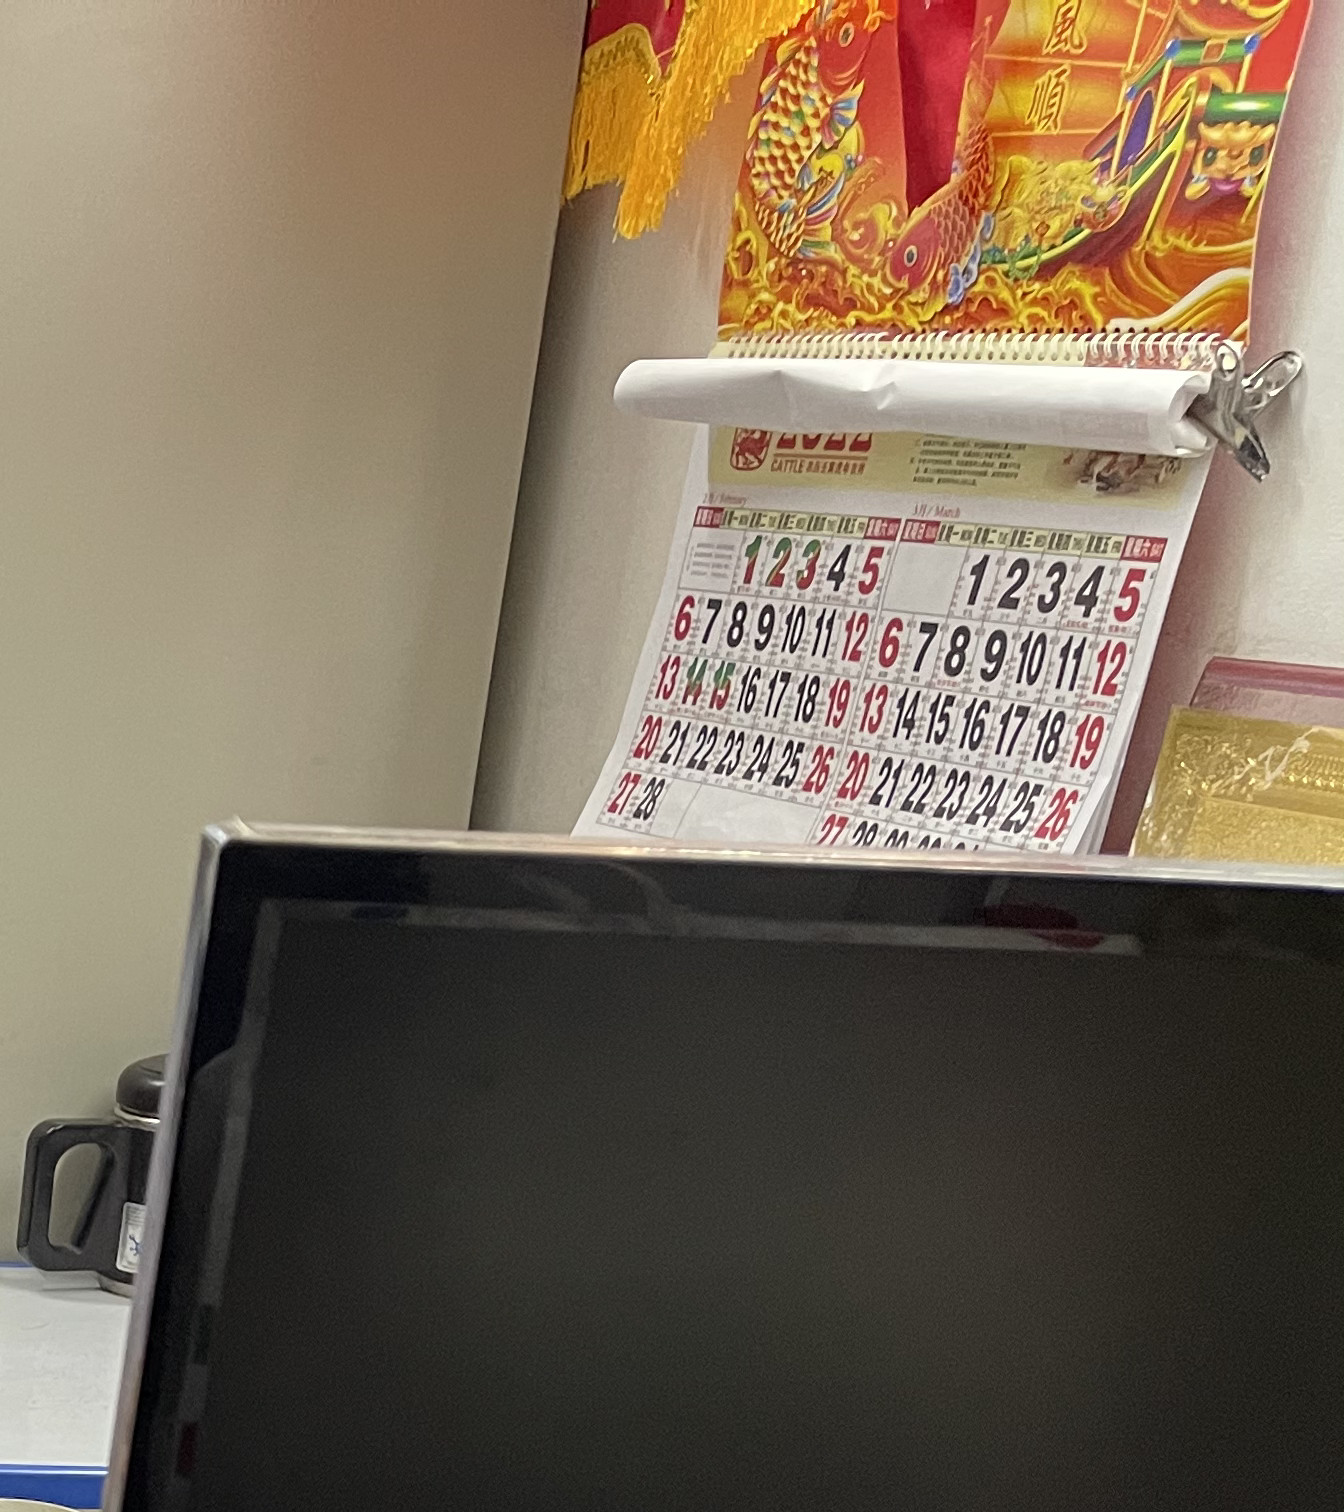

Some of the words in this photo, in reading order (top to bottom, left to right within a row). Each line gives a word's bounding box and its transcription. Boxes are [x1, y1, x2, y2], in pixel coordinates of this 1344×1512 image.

[744, 535, 762, 584] 1
[765, 537, 792, 587] 2
[796, 539, 821, 590] 3
[827, 544, 852, 592] 4
[858, 546, 885, 595] 5
[967, 554, 990, 605] 1
[997, 558, 1030, 609] 2
[1037, 562, 1067, 613] 3
[1074, 565, 1105, 618] 4
[1113, 568, 1146, 622] 5
[674, 595, 695, 641] 6
[702, 599, 722, 644] 7
[726, 601, 747, 647] 8
[754, 604, 775, 650] 9
[781, 604, 806, 653] 10
[811, 608, 837, 658] 11
[841, 611, 869, 662] 12
[878, 617, 903, 668] 6
[913, 622, 939, 672] 7
[944, 625, 971, 677] 8
[980, 629, 1008, 682] 9
[1016, 631, 1047, 686] 10
[1055, 635, 1087, 691] 11
[1092, 640, 1127, 697] 12
[655, 654, 681, 700] 13
[682, 656, 708, 706] 14
[709, 660, 736, 710] 15
[737, 665, 761, 714] 16
[764, 669, 792, 718] 17
[794, 673, 820, 724] 18
[825, 678, 851, 729] 19
[859, 682, 889, 734] 13
[893, 687, 921, 741] 14
[925, 691, 956, 745] 15
[959, 697, 991, 751] 16
[994, 703, 1031, 757] 17
[1032, 708, 1066, 763] 18
[1070, 713, 1105, 770] 19
[633, 714, 663, 760] 20
[659, 719, 691, 766] 21
[686, 725, 718, 771] 22
[714, 729, 744, 777] 23
[742, 734, 775, 783] 24
[772, 740, 805, 789] 25
[802, 744, 835, 795] 26
[607, 771, 642, 816] 27
[633, 776, 666, 821] 28
[837, 749, 870, 801] 20
[868, 756, 905, 808] 21
[900, 762, 937, 815] 22
[933, 768, 971, 821] 23
[965, 774, 1008, 828] 24
[999, 781, 1044, 834] 25
[1034, 787, 1079, 842] 26
